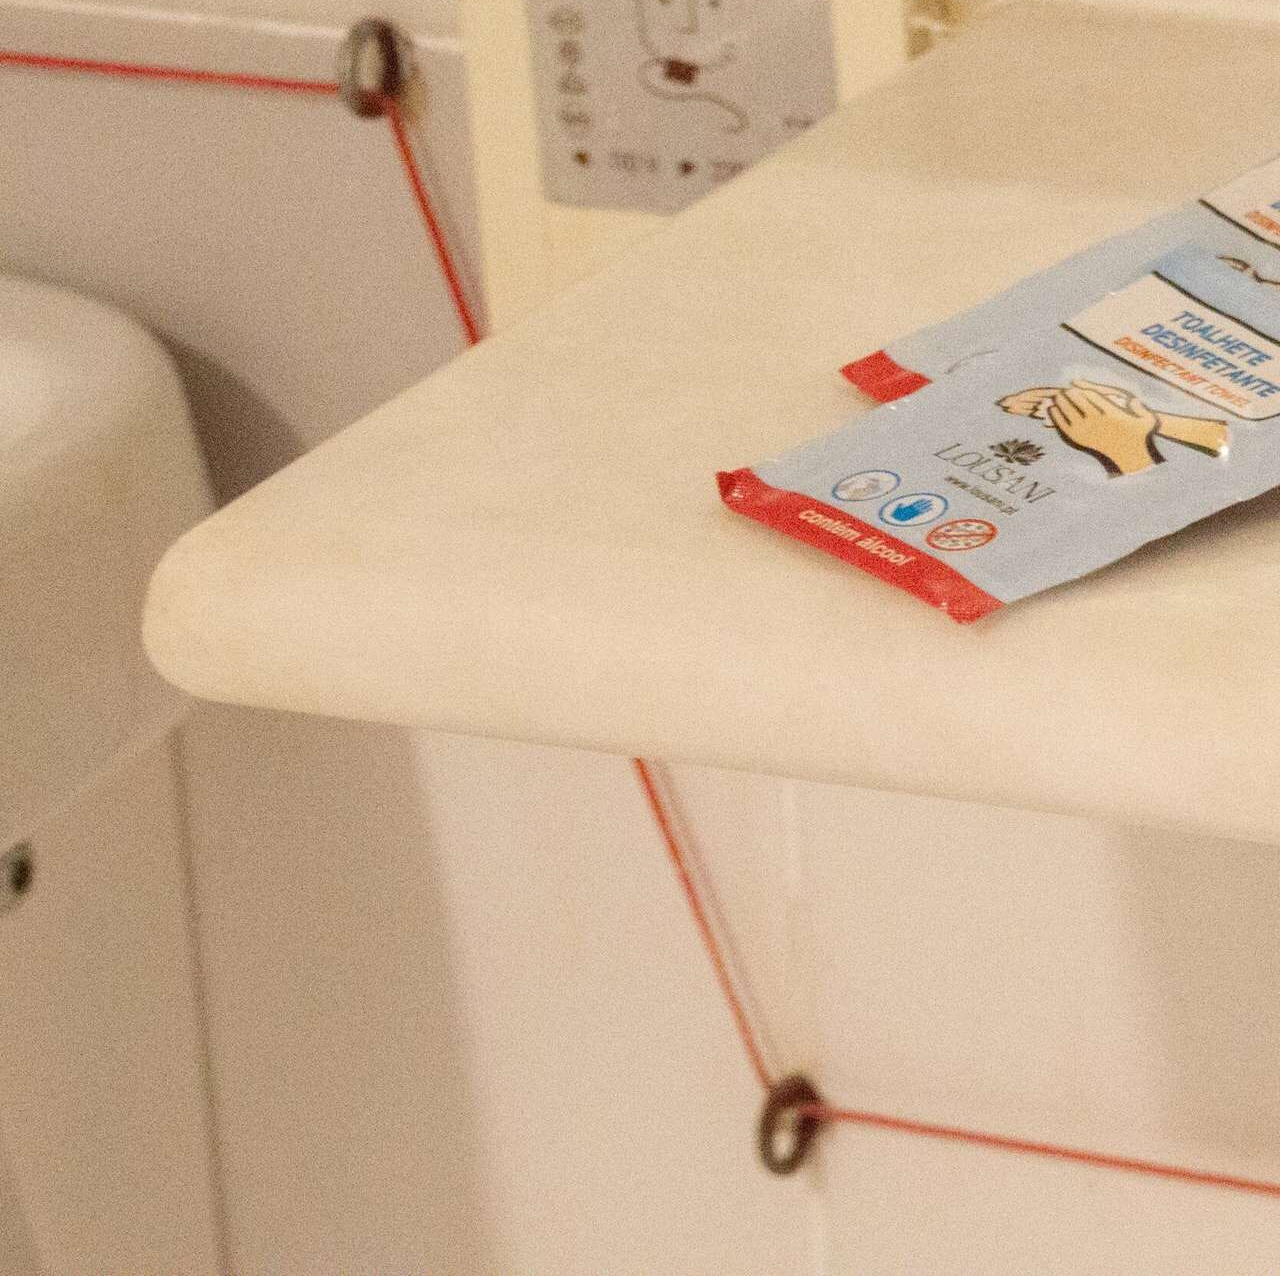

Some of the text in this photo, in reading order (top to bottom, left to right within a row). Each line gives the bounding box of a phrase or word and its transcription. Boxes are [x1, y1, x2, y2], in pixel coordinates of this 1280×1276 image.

[1170, 310, 1272, 366] TOALHETE
[1114, 336, 1251, 408] DISINFECTANT TOWEL
[932, 442, 1057, 503] LOUSANI
[797, 509, 916, 566] contém álcool
